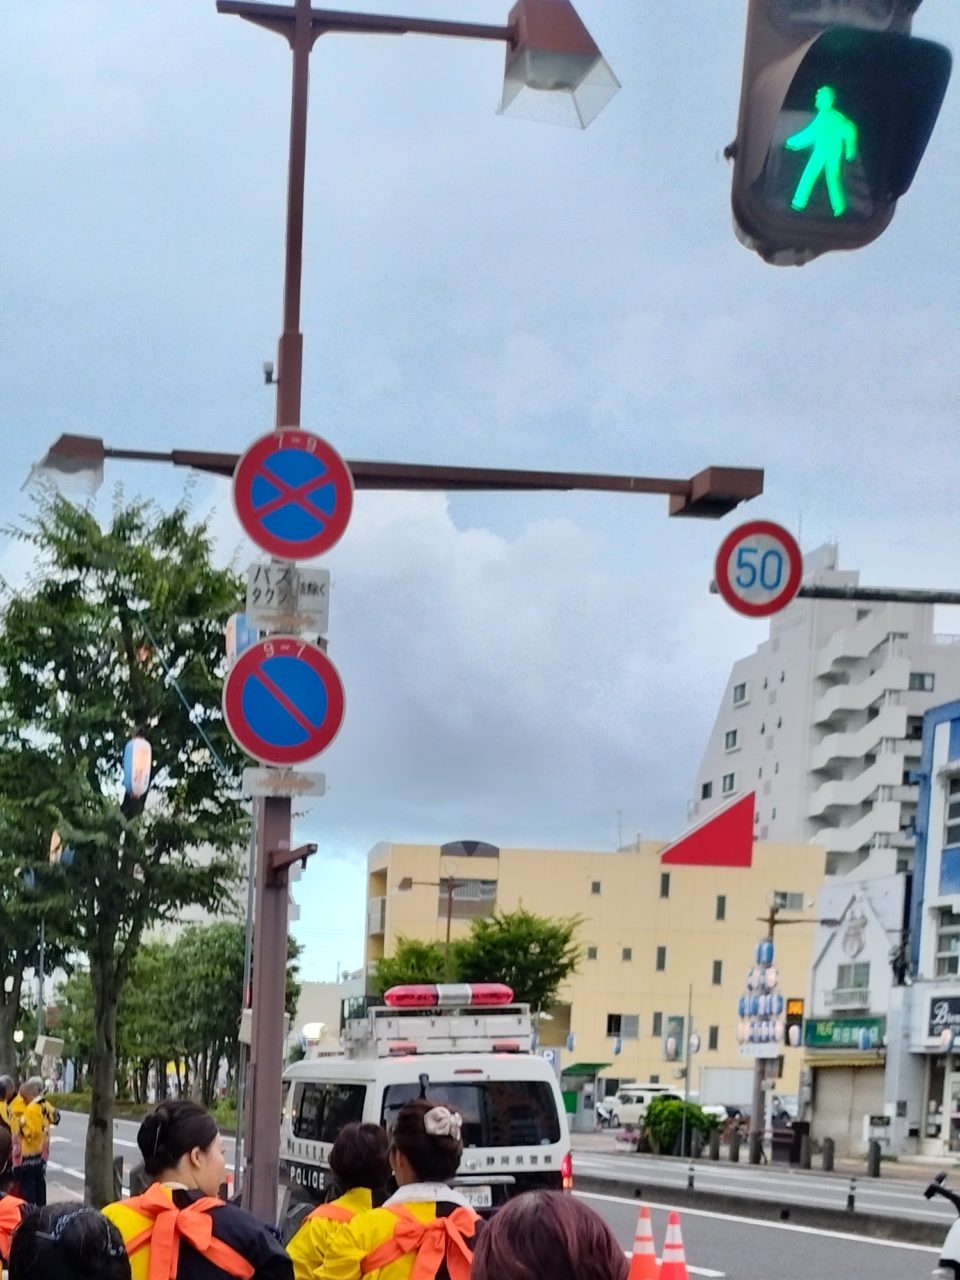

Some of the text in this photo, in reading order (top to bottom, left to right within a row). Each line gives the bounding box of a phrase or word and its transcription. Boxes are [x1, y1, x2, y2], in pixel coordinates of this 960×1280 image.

[735, 547, 783, 591] 50
[486, 1154, 552, 1166] 静岡県警察
[290, 1166, 325, 1190] POLICE
